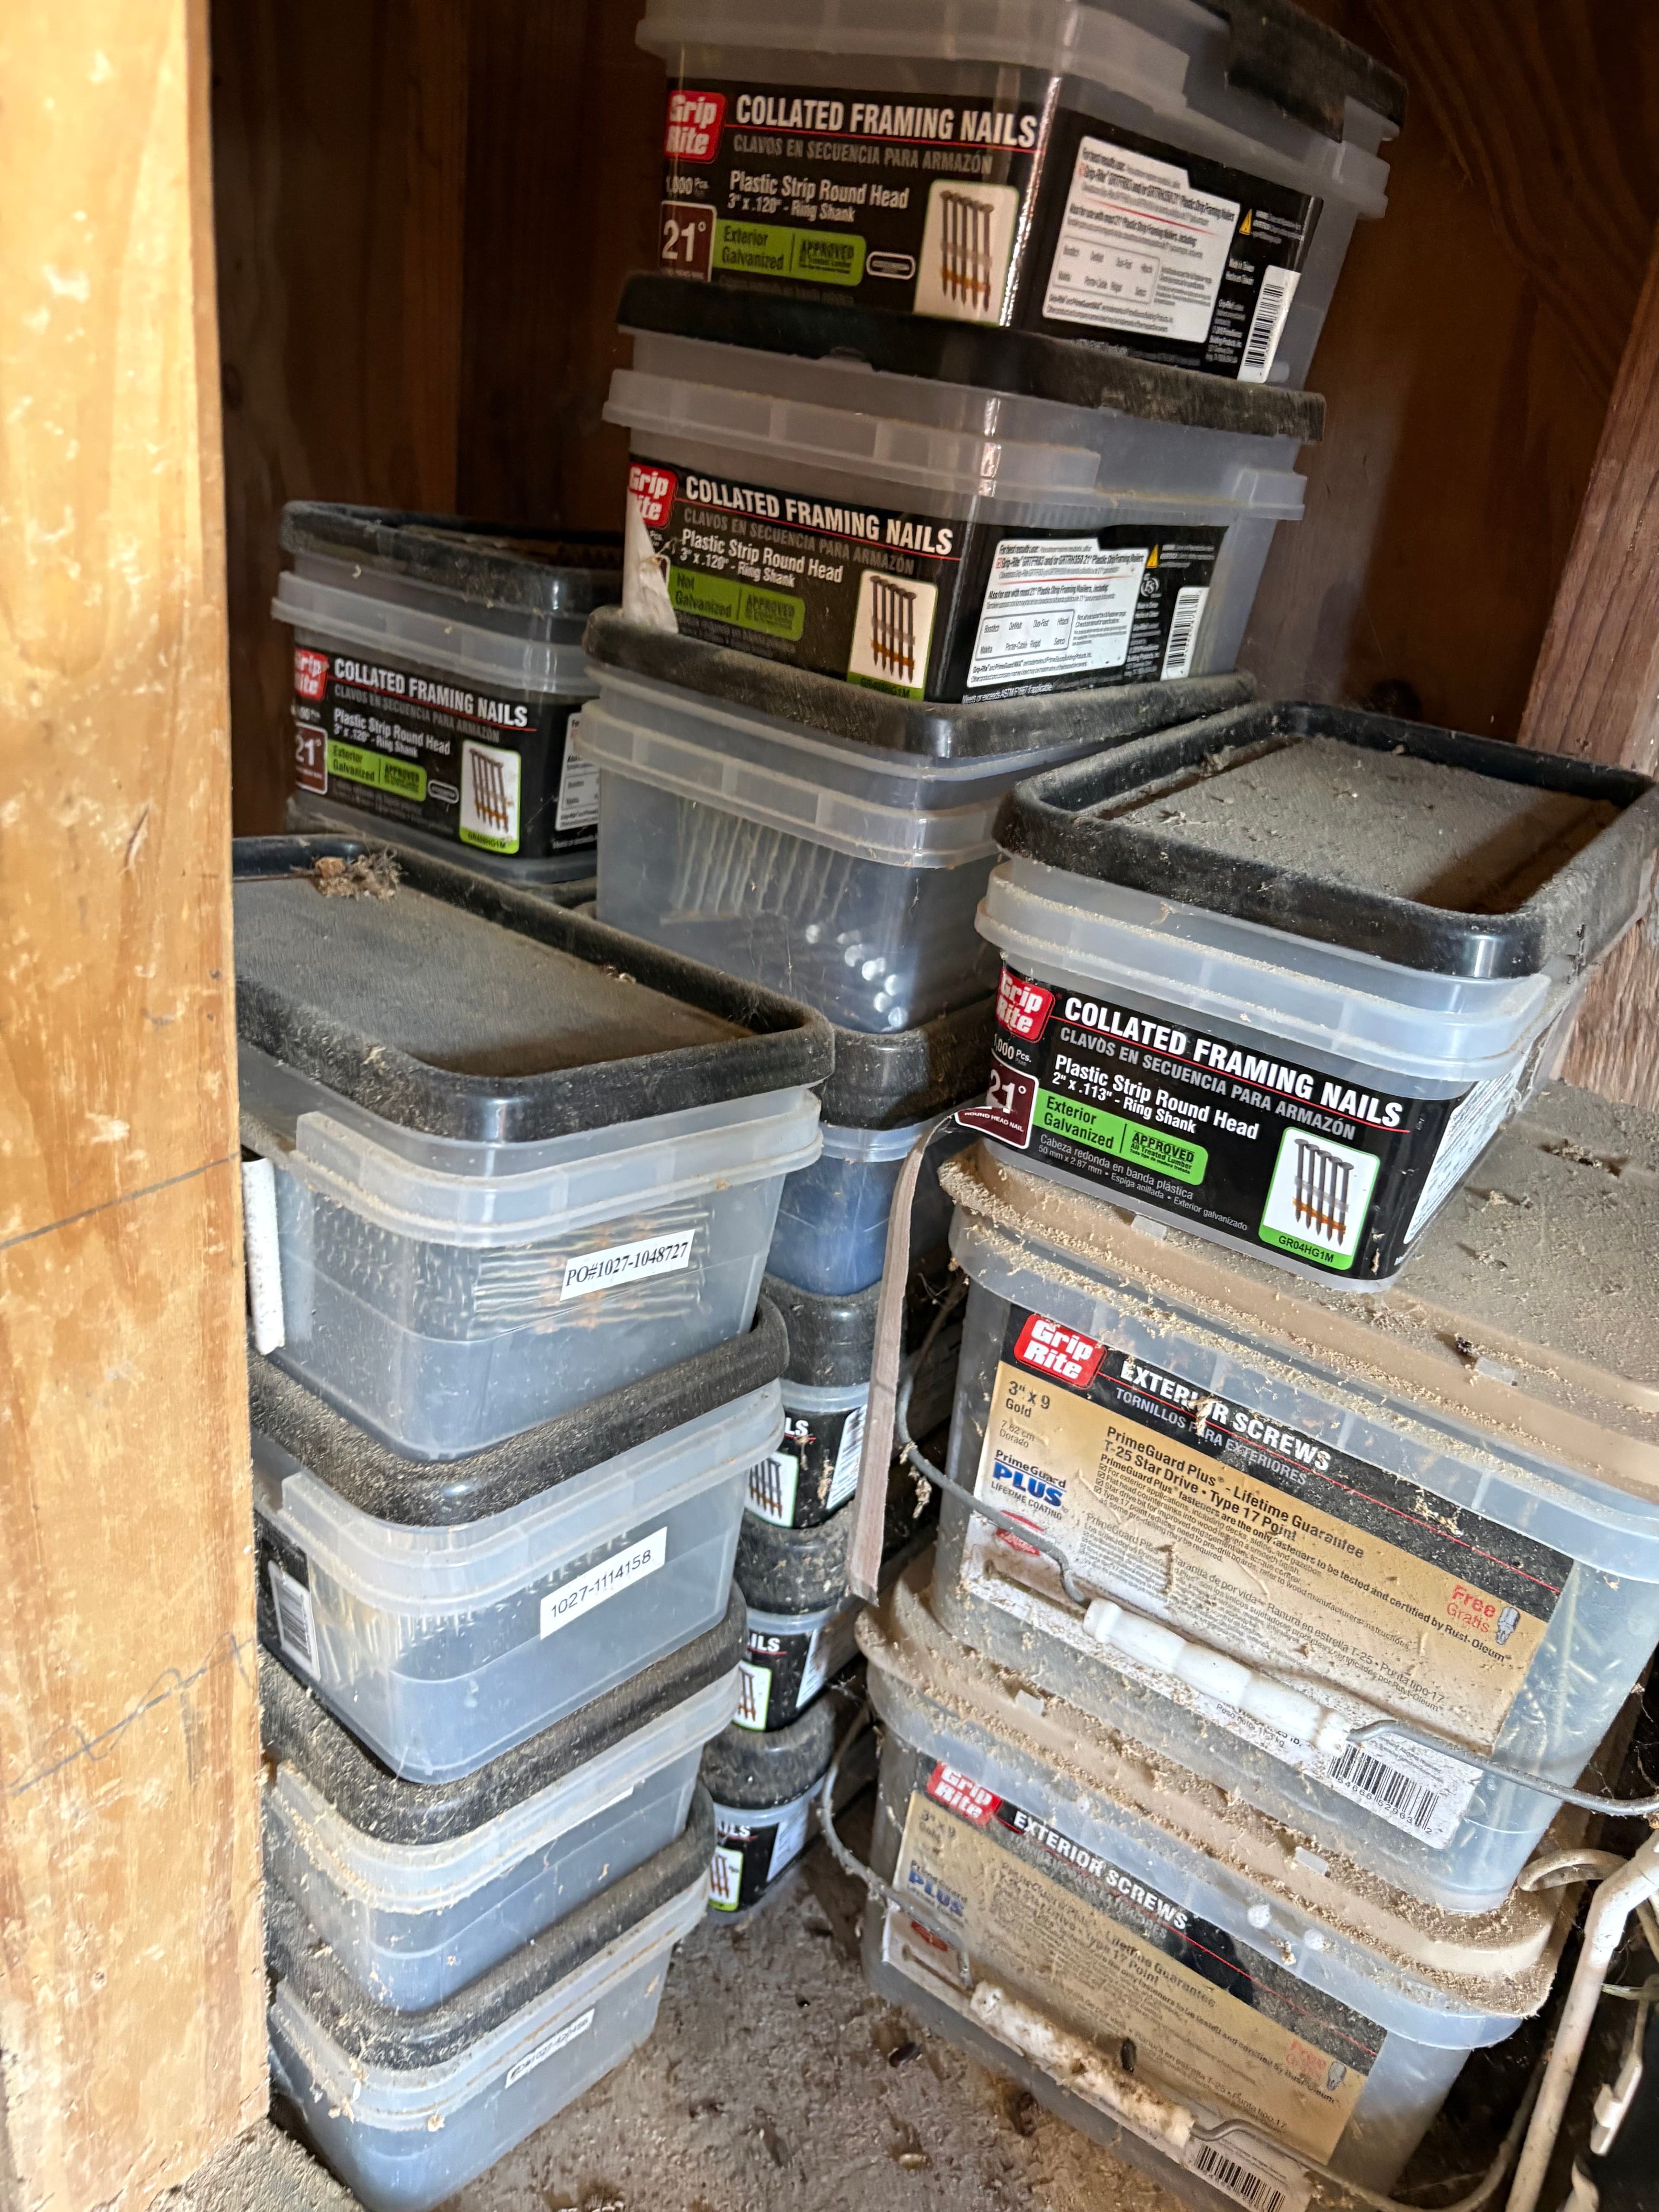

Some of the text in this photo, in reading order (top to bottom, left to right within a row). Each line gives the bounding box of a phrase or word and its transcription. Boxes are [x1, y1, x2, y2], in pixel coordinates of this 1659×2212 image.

[670, 94, 718, 129] Grip
[736, 94, 1037, 148] COLLATED FRAMING NAILS
[665, 125, 710, 155] Rite
[734, 133, 993, 175] CLAVOS EN SECUENCIA PARA ARMAZÓN
[730, 170, 910, 209] Plastic Strip Round Head
[791, 200, 855, 222] Ring Shank
[724, 225, 769, 247] Exterior
[801, 239, 855, 260] APPROVED
[722, 246, 784, 270] Galvanized
[629, 466, 669, 499] Grip
[639, 494, 663, 521] ite
[686, 475, 953, 555] COLLATED FRAMING NAILS
[681, 528, 725, 554] Plastic
[728, 538, 760, 564] Strip
[763, 547, 806, 573] Round
[807, 558, 844, 583] Head
[684, 508, 914, 575] CLAVOS EN SECUENCIA PARA ARMAZÓN
[737, 561, 796, 588] Ring Shank
[675, 591, 732, 618] Galvanized
[334, 658, 528, 728] COLLATED FRAMING NAILS
[334, 683, 368, 704] CLAVOS
[369, 692, 381, 707] EN
[432, 711, 455, 730] PARA
[333, 707, 367, 730] Plastic
[368, 717, 392, 737] Strip
[392, 724, 425, 747] Round
[426, 733, 451, 756] Head
[332, 744, 363, 764] Exterior
[332, 759, 376, 783] Galvanized
[1000, 973, 1043, 1014] Grip
[996, 995, 1033, 1034] Rite
[1016, 1049, 1032, 1063] Pcs.
[1064, 997, 1404, 1127] COLLATED FRAMING NAILS
[1052, 1072, 1197, 1134] 2" x .113" Ring Shank
[1055, 1054, 1260, 1140] Plastic Strip Round Head
[1060, 1027, 1356, 1141] CLAVOS EN SECUENCIA PARA ARMAZÓN
[991, 1115, 1009, 1125] HEAD
[1009, 1121, 1024, 1132] NAIL
[1046, 1095, 1097, 1125] Exterior
[1043, 1112, 1115, 1150] Galvanized
[1132, 1132, 1195, 1163] APPROVED
[1040, 1133, 1195, 1200] Cabeza redonda en banda plástica
[1130, 1143, 1192, 1170] All Treated Lumber
[1039, 1145, 1248, 1231] 50 mm 2.87 mm Espiga anillada Exterior galvanizado
[565, 1241, 689, 1287] PO#1027-1048727
[1278, 1235, 1334, 1263] GR04HG1M
[1030, 1319, 1094, 1361] Grip
[1023, 1340, 1083, 1380] Rite
[1006, 1398, 1033, 1418] Gold
[1007, 1380, 1051, 1410] 3" x 9
[1022, 1428, 1036, 1442] cm
[1120, 1360, 1332, 1471] EXTERIR SCREWS
[999, 1428, 1030, 1449] Dorado
[1116, 1386, 1306, 1487] TORNILLOS PRA EXTERIORES
[993, 1461, 1064, 1507] PLUS
[995, 1449, 1067, 1489] PrimeGuard
[990, 1480, 1063, 1521] LIFETIME COATING
[1103, 1440, 1297, 1541] T-25 Star Drive Type 17 Point
[1106, 1426, 1364, 1559] PrimeGuard Lifetime Guarantee
[1100, 1454, 1153, 1484] PrimeGuard
[1179, 1491, 1220, 1517] fasteners
[1221, 1513, 1236, 1525] are
[1237, 1519, 1252, 1533] the
[1252, 1528, 1272, 1544] only
[1326, 1563, 1340, 1576] be
[1340, 1570, 1370, 1592] tested
[1371, 1585, 1389, 1601] and
[1389, 1598, 1431, 1624] certified
[1431, 1615, 1445, 1630] by
[551, 1550, 651, 1618] 1027-1114158
[1452, 1584, 1496, 1619] Free
[1446, 1602, 1491, 1634] Gratis
[750, 1633, 781, 1653] ILS
[1350, 1644, 1374, 1665] T-25
[934, 1780, 983, 1818] Rite
[940, 1766, 992, 1806] Grip
[718, 1818, 751, 1837] ILS
[1378, 1799, 1413, 1824] 52963
[1014, 1810, 1105, 1878] EXTERIOR
[1106, 1869, 1189, 1930] SCREWS
